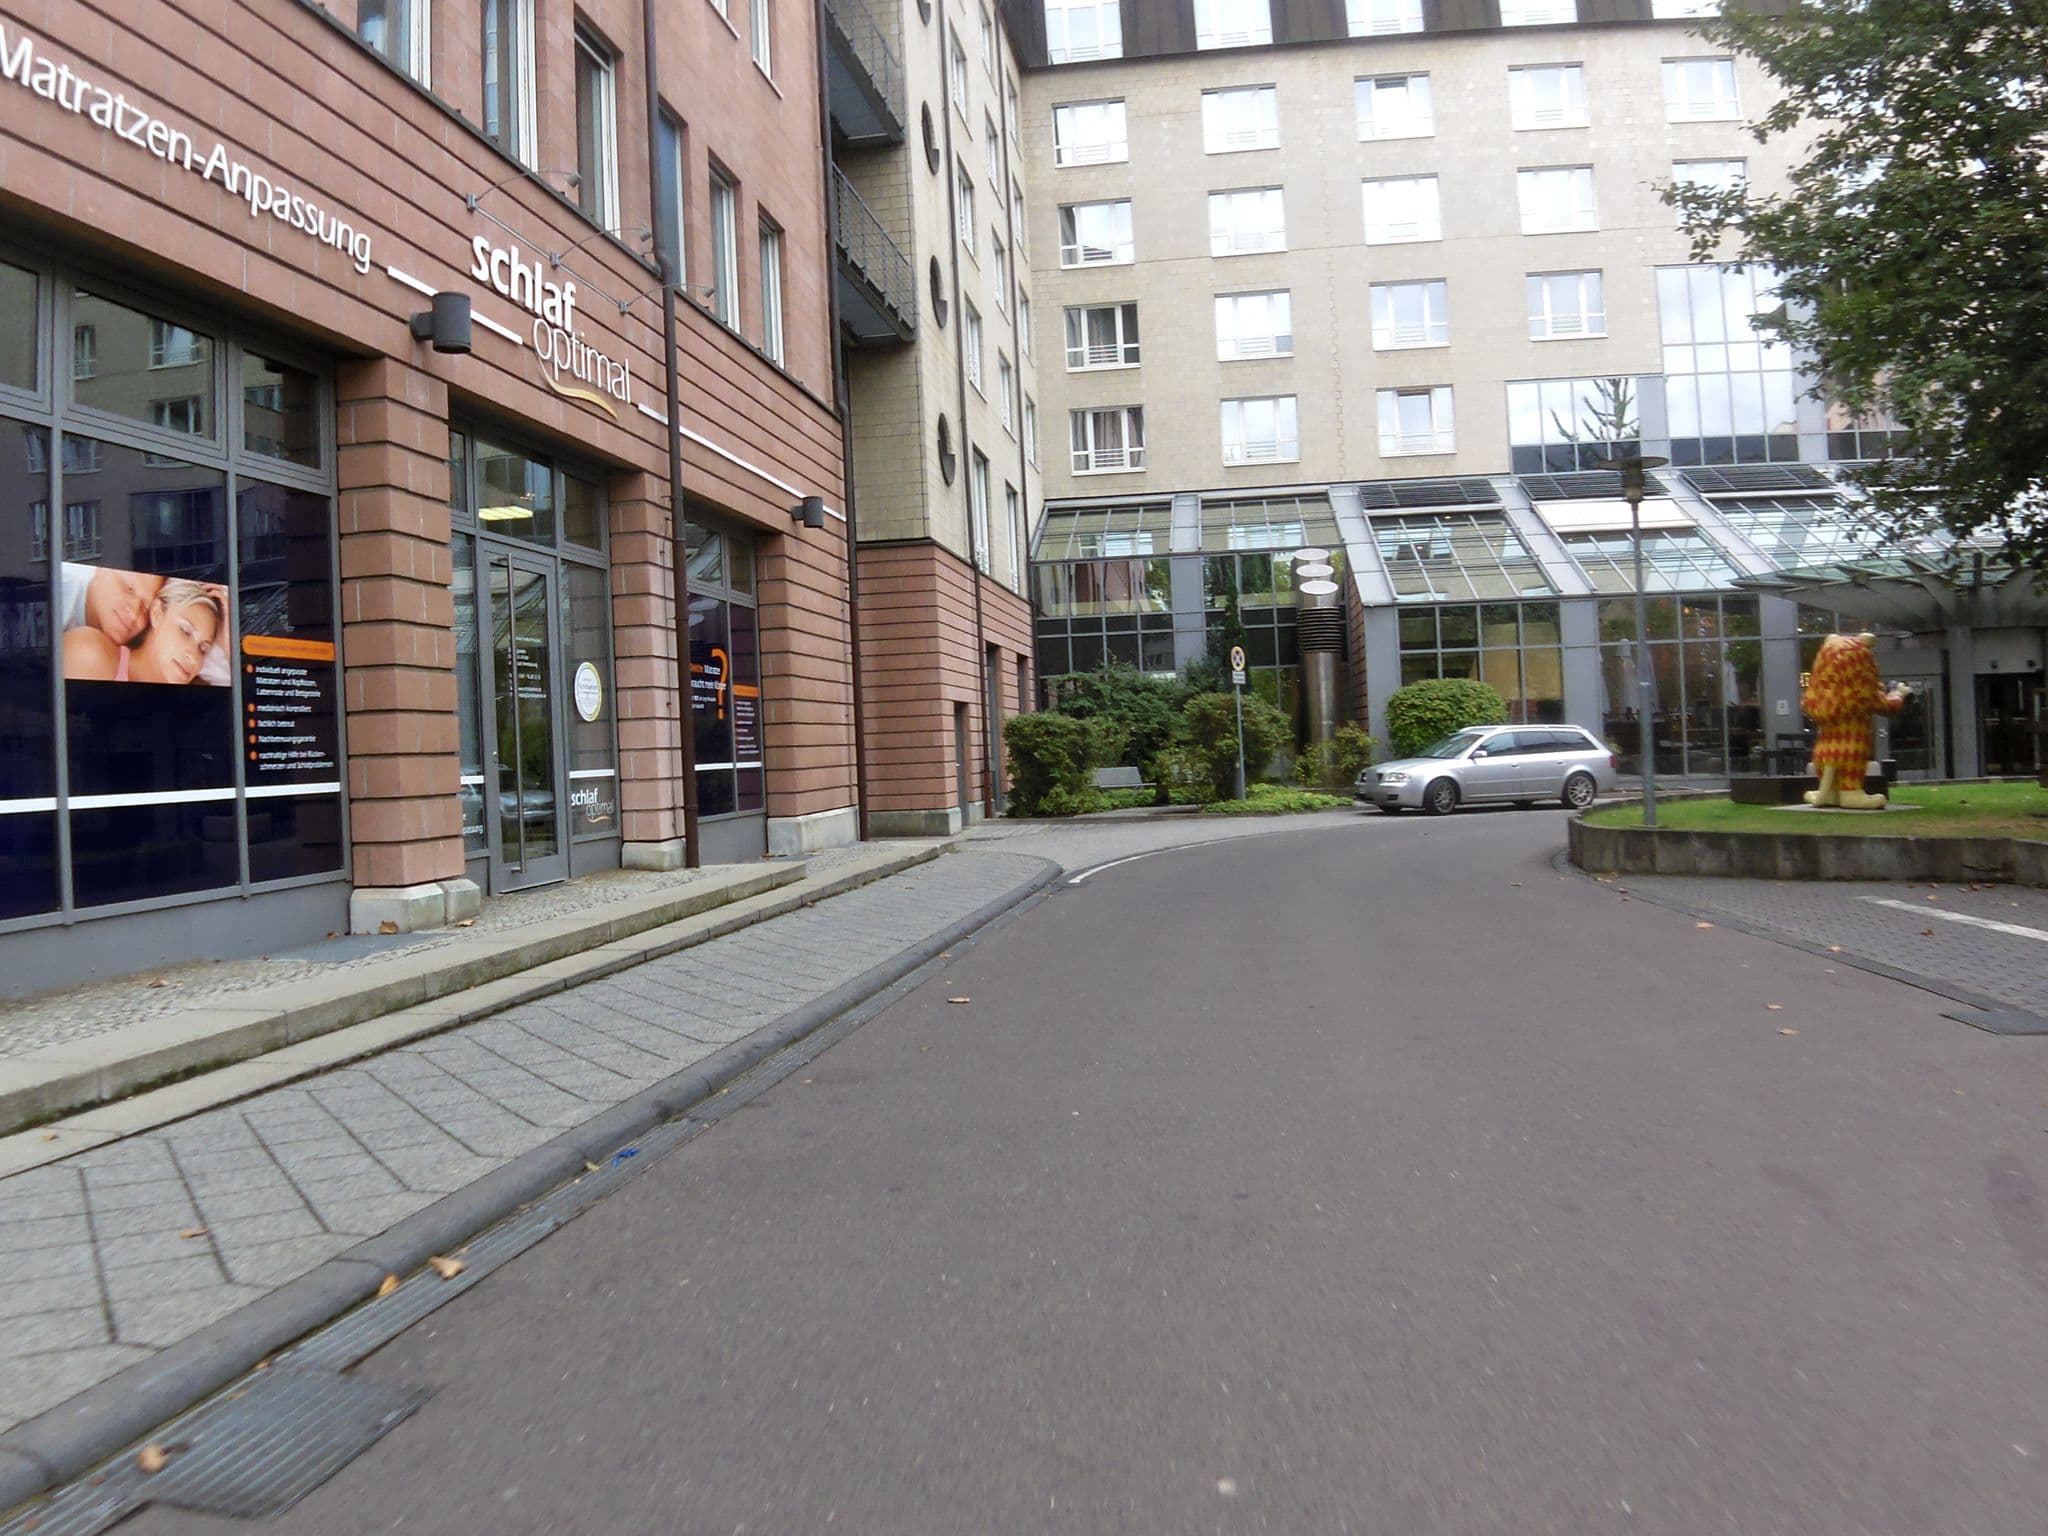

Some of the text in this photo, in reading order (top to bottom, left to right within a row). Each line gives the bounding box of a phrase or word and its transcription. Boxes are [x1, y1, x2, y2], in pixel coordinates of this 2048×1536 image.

[0, 23, 371, 275] Matratzen-Anpassung
[471, 235, 576, 333] schlaf
[533, 318, 631, 404] optimal
[571, 788, 599, 806] schlaf
[586, 801, 614, 819] optimal
